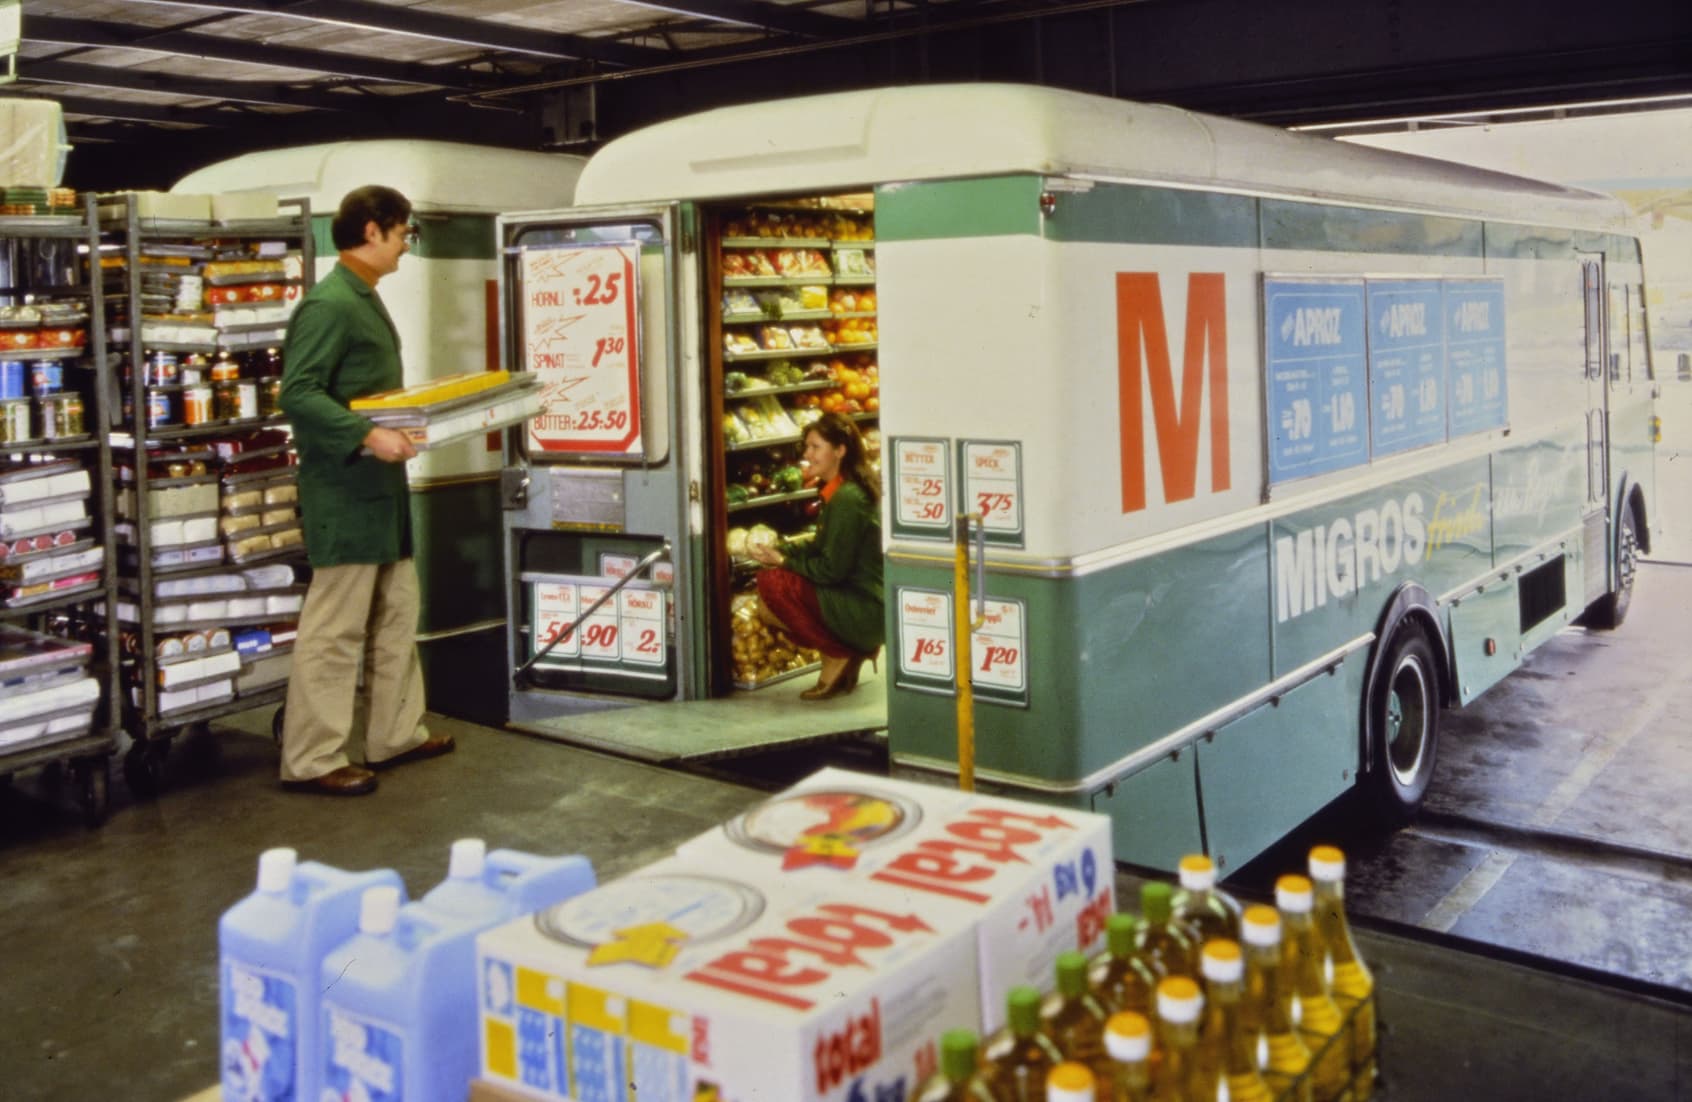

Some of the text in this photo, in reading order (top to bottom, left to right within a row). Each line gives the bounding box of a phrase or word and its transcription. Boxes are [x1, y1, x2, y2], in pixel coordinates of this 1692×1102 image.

[1116, 272, 1231, 513] M
[1276, 493, 1425, 623] MIGROS
[871, 807, 1077, 904] total
[682, 903, 937, 1011] total
